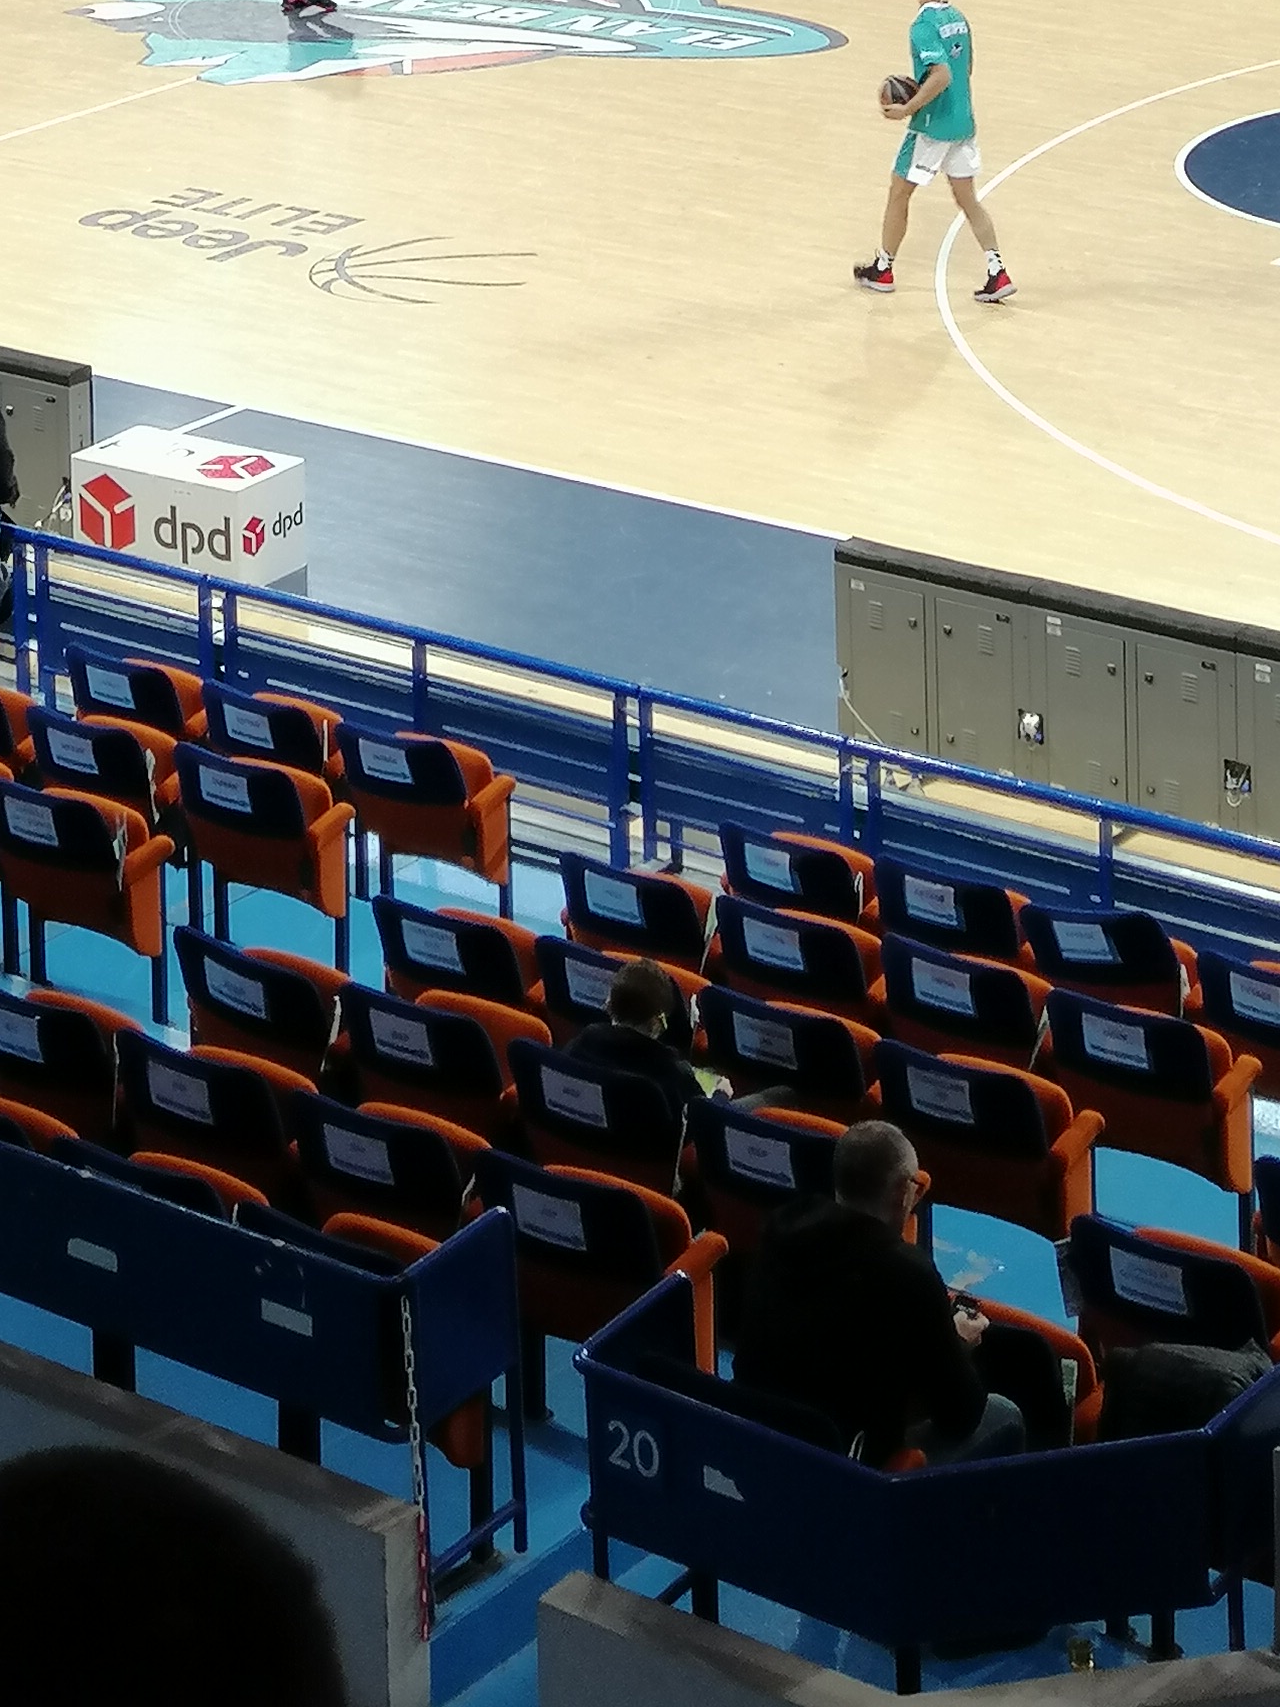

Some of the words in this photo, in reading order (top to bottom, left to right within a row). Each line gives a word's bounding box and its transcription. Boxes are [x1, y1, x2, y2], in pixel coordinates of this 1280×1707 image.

[548, 11, 770, 54] ELAN
[77, 208, 309, 263] Jeep
[153, 505, 232, 565] dpd
[272, 501, 304, 538] dpd
[607, 1419, 660, 1478] 20
